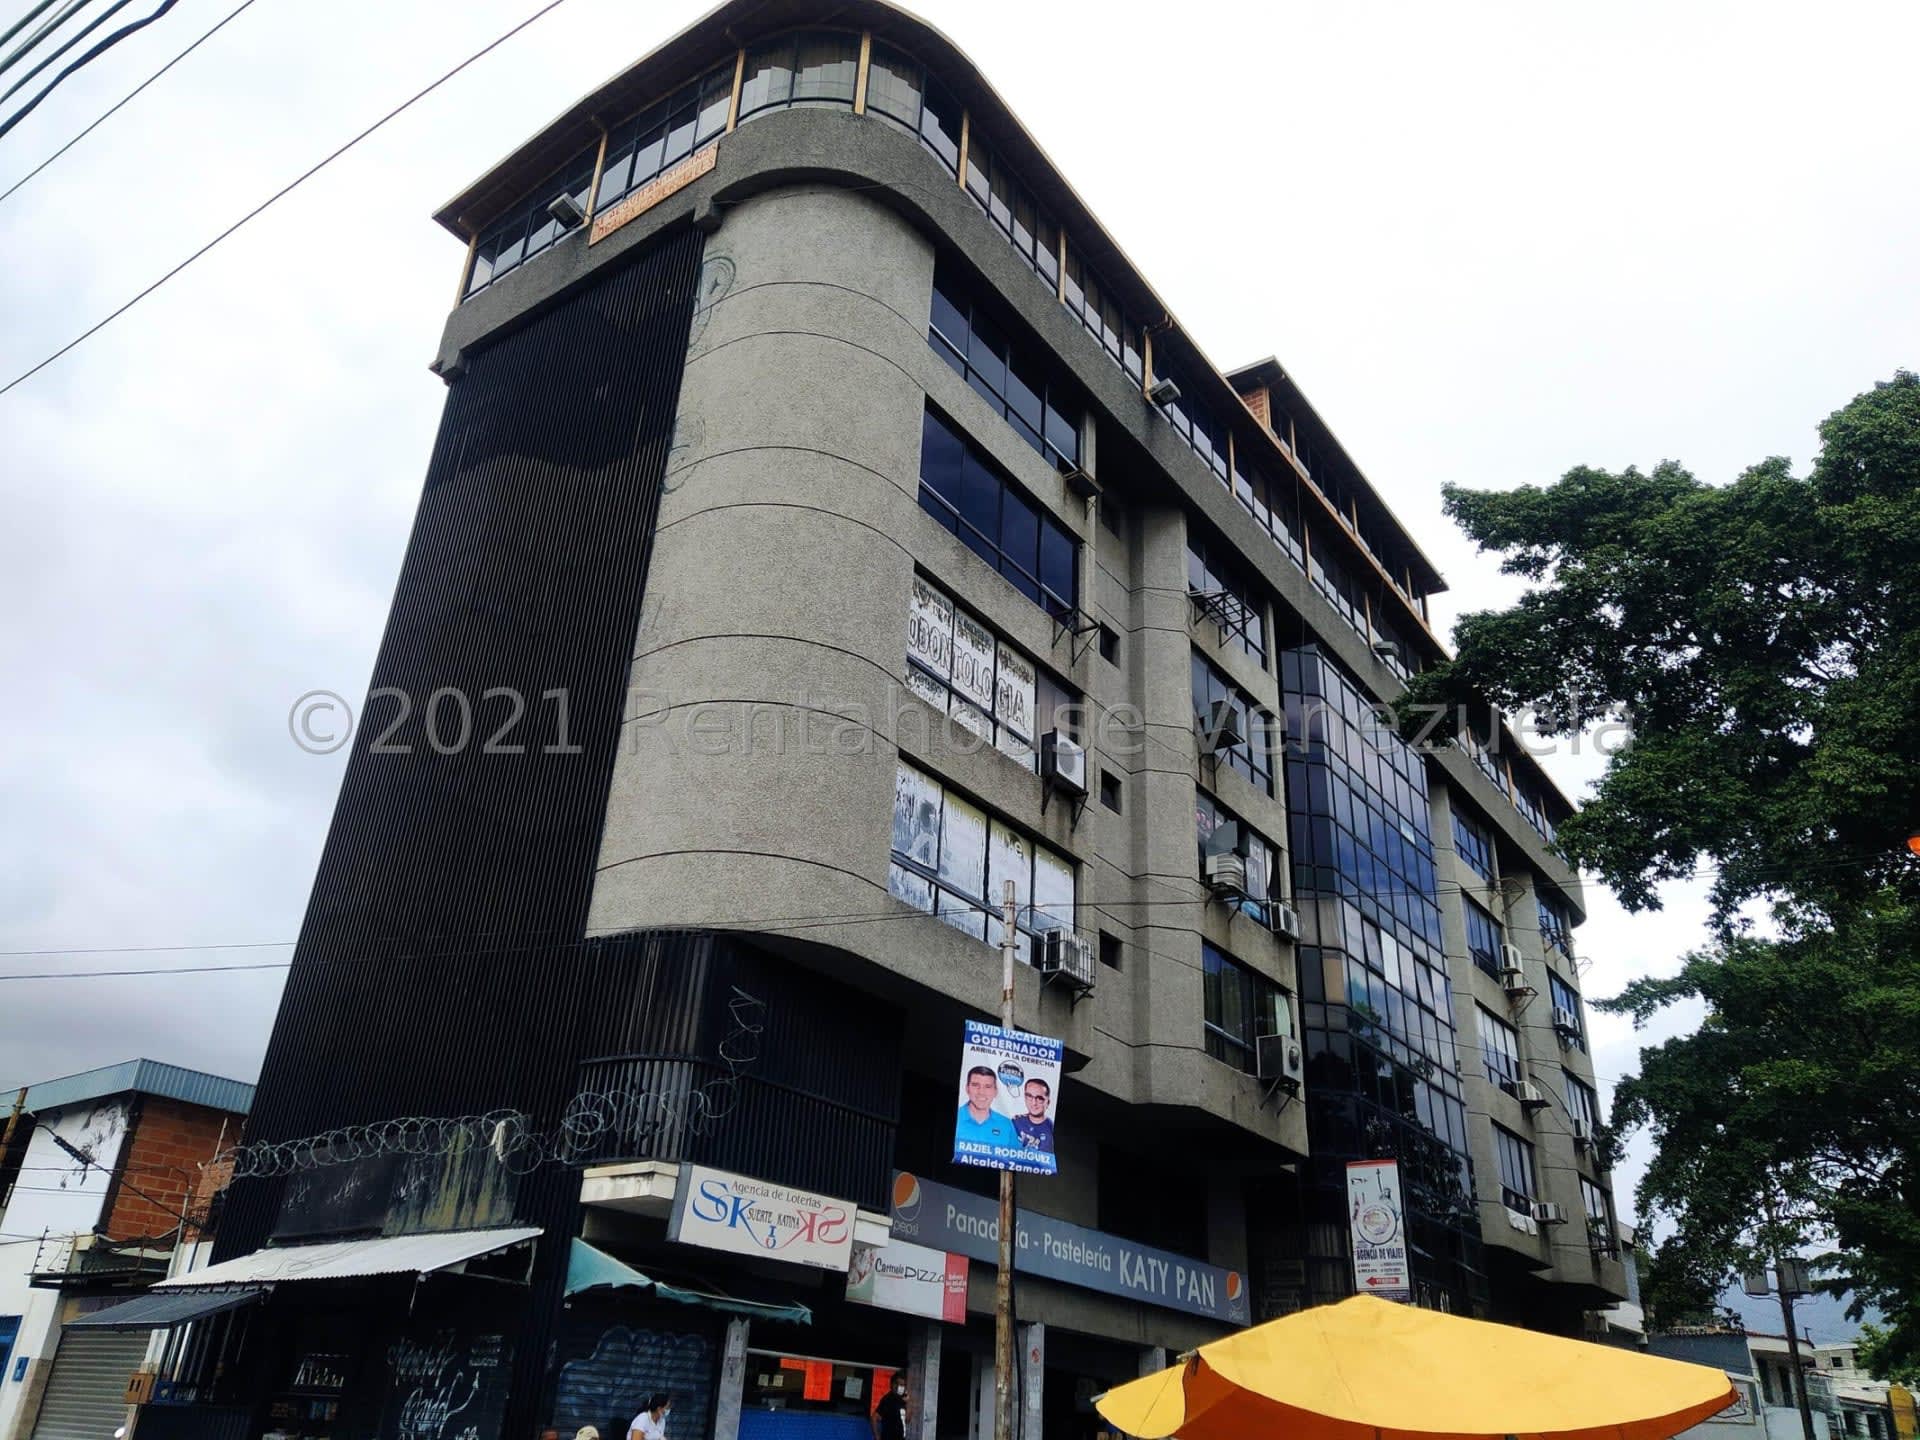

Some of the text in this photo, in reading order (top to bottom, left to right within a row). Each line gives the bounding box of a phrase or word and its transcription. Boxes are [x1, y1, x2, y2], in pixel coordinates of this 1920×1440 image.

[968, 1022, 1060, 1048] DAVID UZCATEGUI
[970, 1045, 997, 1056] ARRIBA
[1012, 1053, 1020, 1061] LA
[1021, 1056, 1055, 1068] DERECHA
[971, 1034, 1056, 1060] GOBERNADOR
[959, 1142, 1050, 1164] RAZIEL RODRÍGUEZ
[961, 1155, 1005, 1169] Alcalde
[732, 1181, 769, 1199] Agencia
[771, 1189, 784, 1200] de
[747, 1208, 801, 1229] SUERTE KATINA
[892, 1220, 919, 1236] pepsi
[947, 1205, 1028, 1249] Panadía
[1044, 1232, 1111, 1273] Pastelería
[1120, 1249, 1169, 1295] KATY
[1176, 1266, 1215, 1308] PAN
[1357, 1247, 1404, 1260] AGENCIA DE VIAJES
